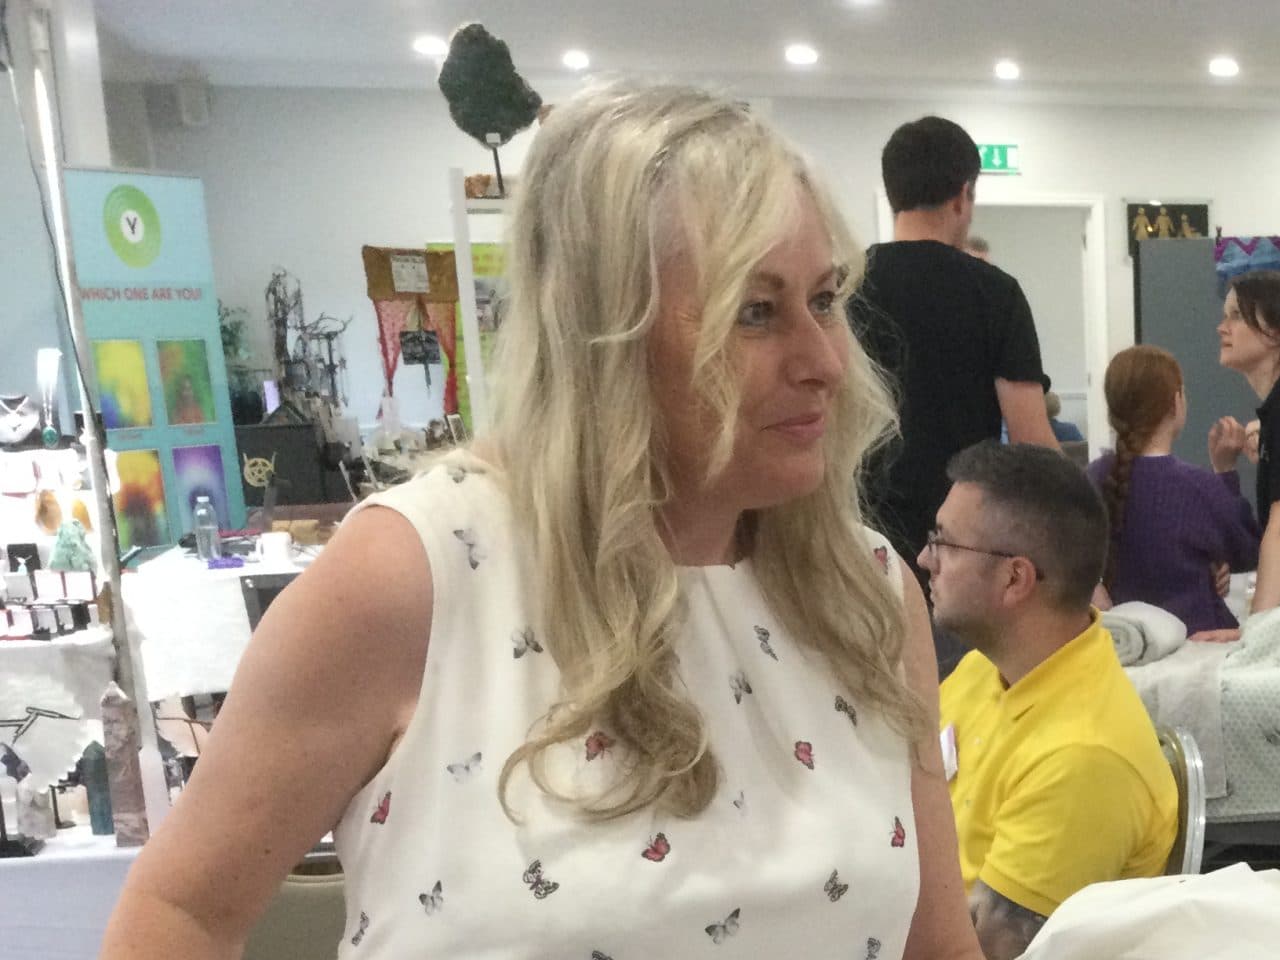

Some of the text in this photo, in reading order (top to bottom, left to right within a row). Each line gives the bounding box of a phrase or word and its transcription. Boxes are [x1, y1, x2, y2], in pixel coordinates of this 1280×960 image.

[80, 287, 121, 300] WHICH
[124, 287, 150, 300] ONE
[152, 287, 172, 300] ARE
